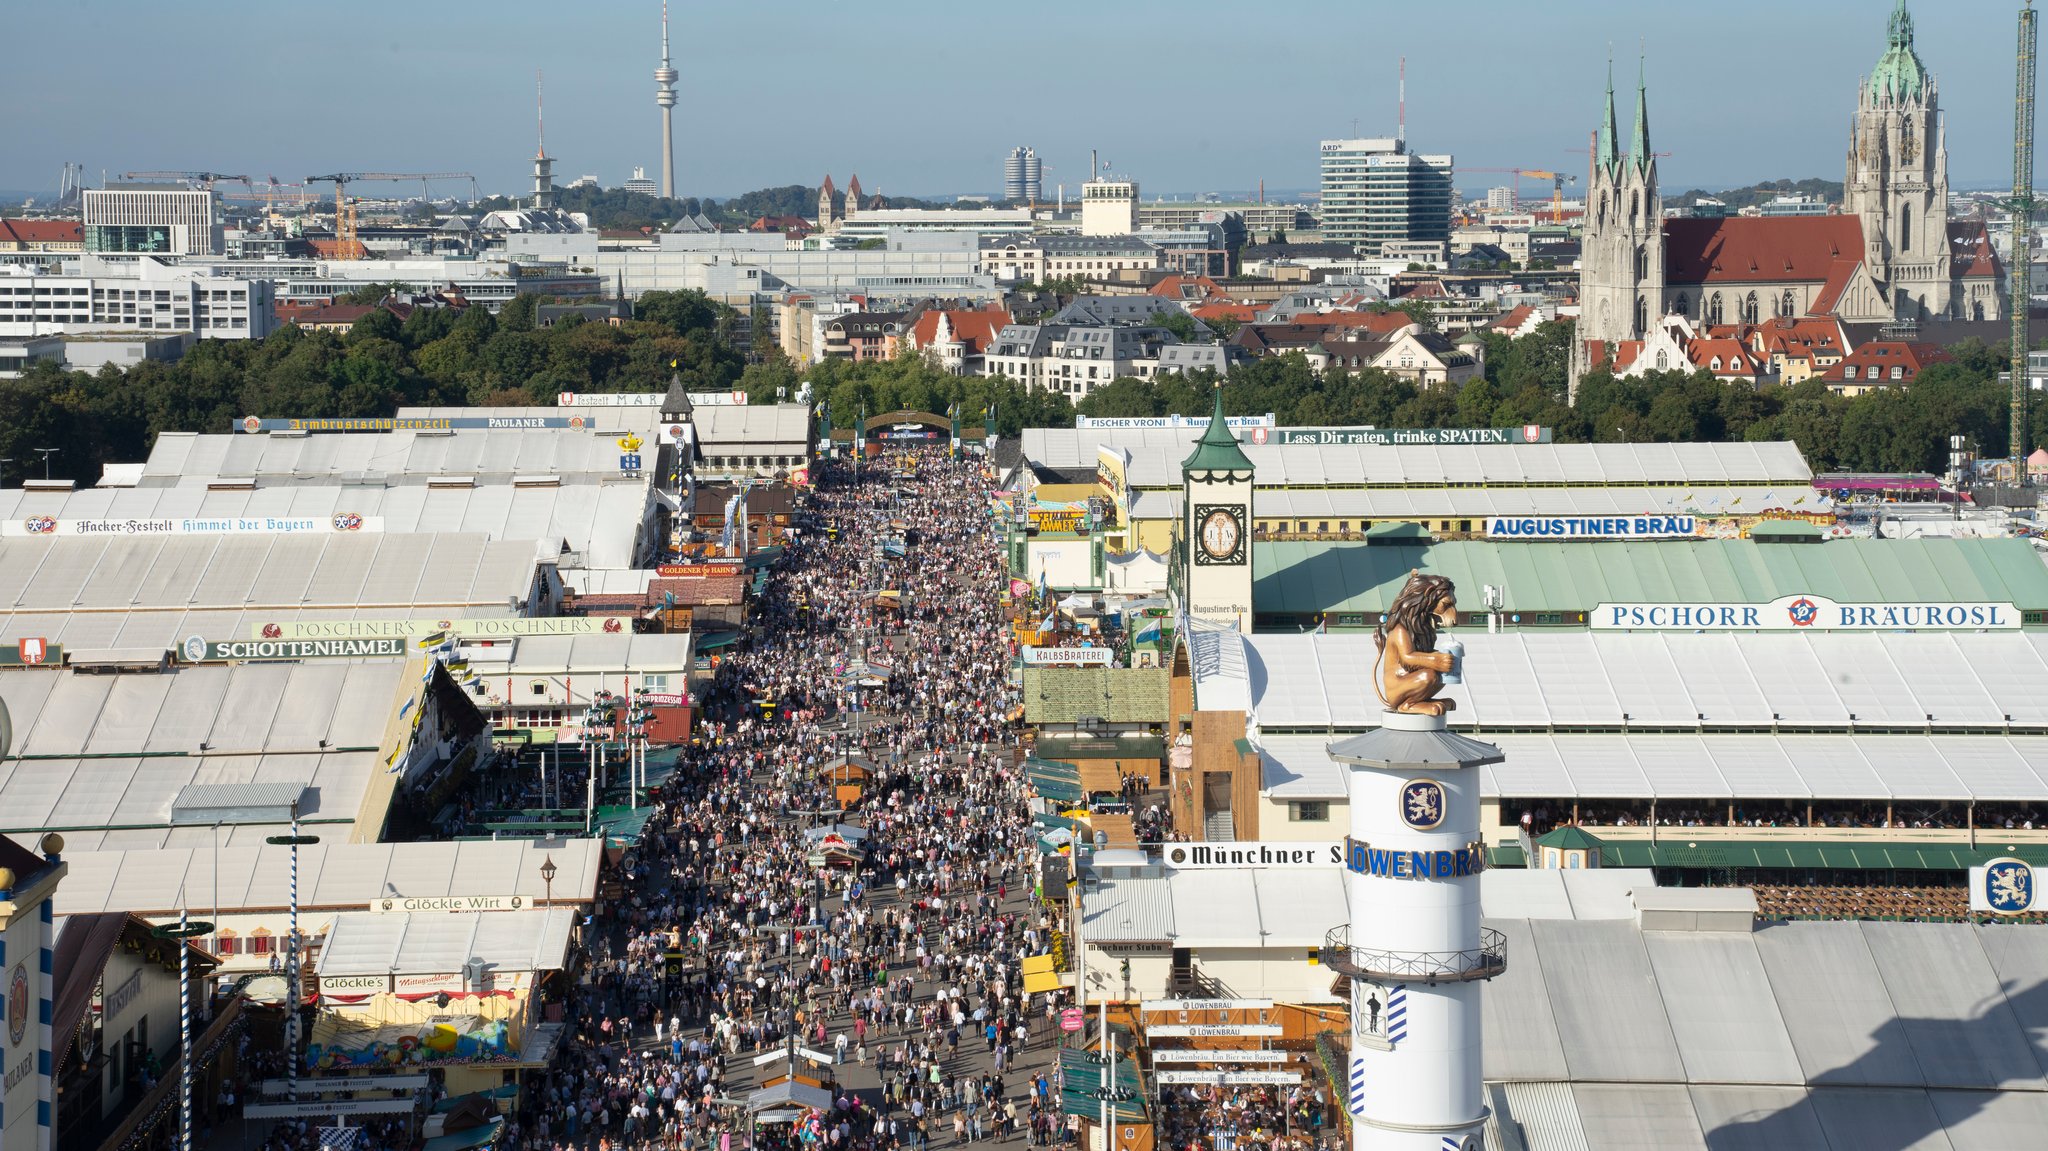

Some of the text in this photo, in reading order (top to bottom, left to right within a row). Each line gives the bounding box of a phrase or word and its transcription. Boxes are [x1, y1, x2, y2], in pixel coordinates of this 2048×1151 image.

[616, 394, 722, 405] MARALL
[289, 418, 450, 430] Armbrustschützenzelt
[488, 418, 545, 428] PAULANER
[1091, 418, 1166, 427] FISCHER VRONI
[1186, 415, 1260, 427] Auguner Bräu
[1284, 429, 1507, 445] Lass Dir raten, trinke SPATEN.
[76, 518, 314, 534] Hacker-Festzelt Himmel der Bayern
[1040, 519, 1076, 532] AMMER
[1492, 516, 1694, 535] AUGUSTINER BRÄU
[711, 566, 731, 574] HAHN
[1612, 606, 1761, 626] PSCHORR
[1839, 605, 2006, 626] BRÄUROSL
[295, 620, 415, 637] POSCHNER'S
[475, 618, 592, 634] POSCHNER'S
[216, 639, 402, 658] SCHOTTENHAMEL
[1192, 845, 1316, 865] Münchner
[404, 897, 500, 910] Glöckle Wirt
[324, 976, 384, 989] Glöckle's
[1225, 1052, 1240, 1061] Bier
[1234, 1074, 1249, 1083] Bier
